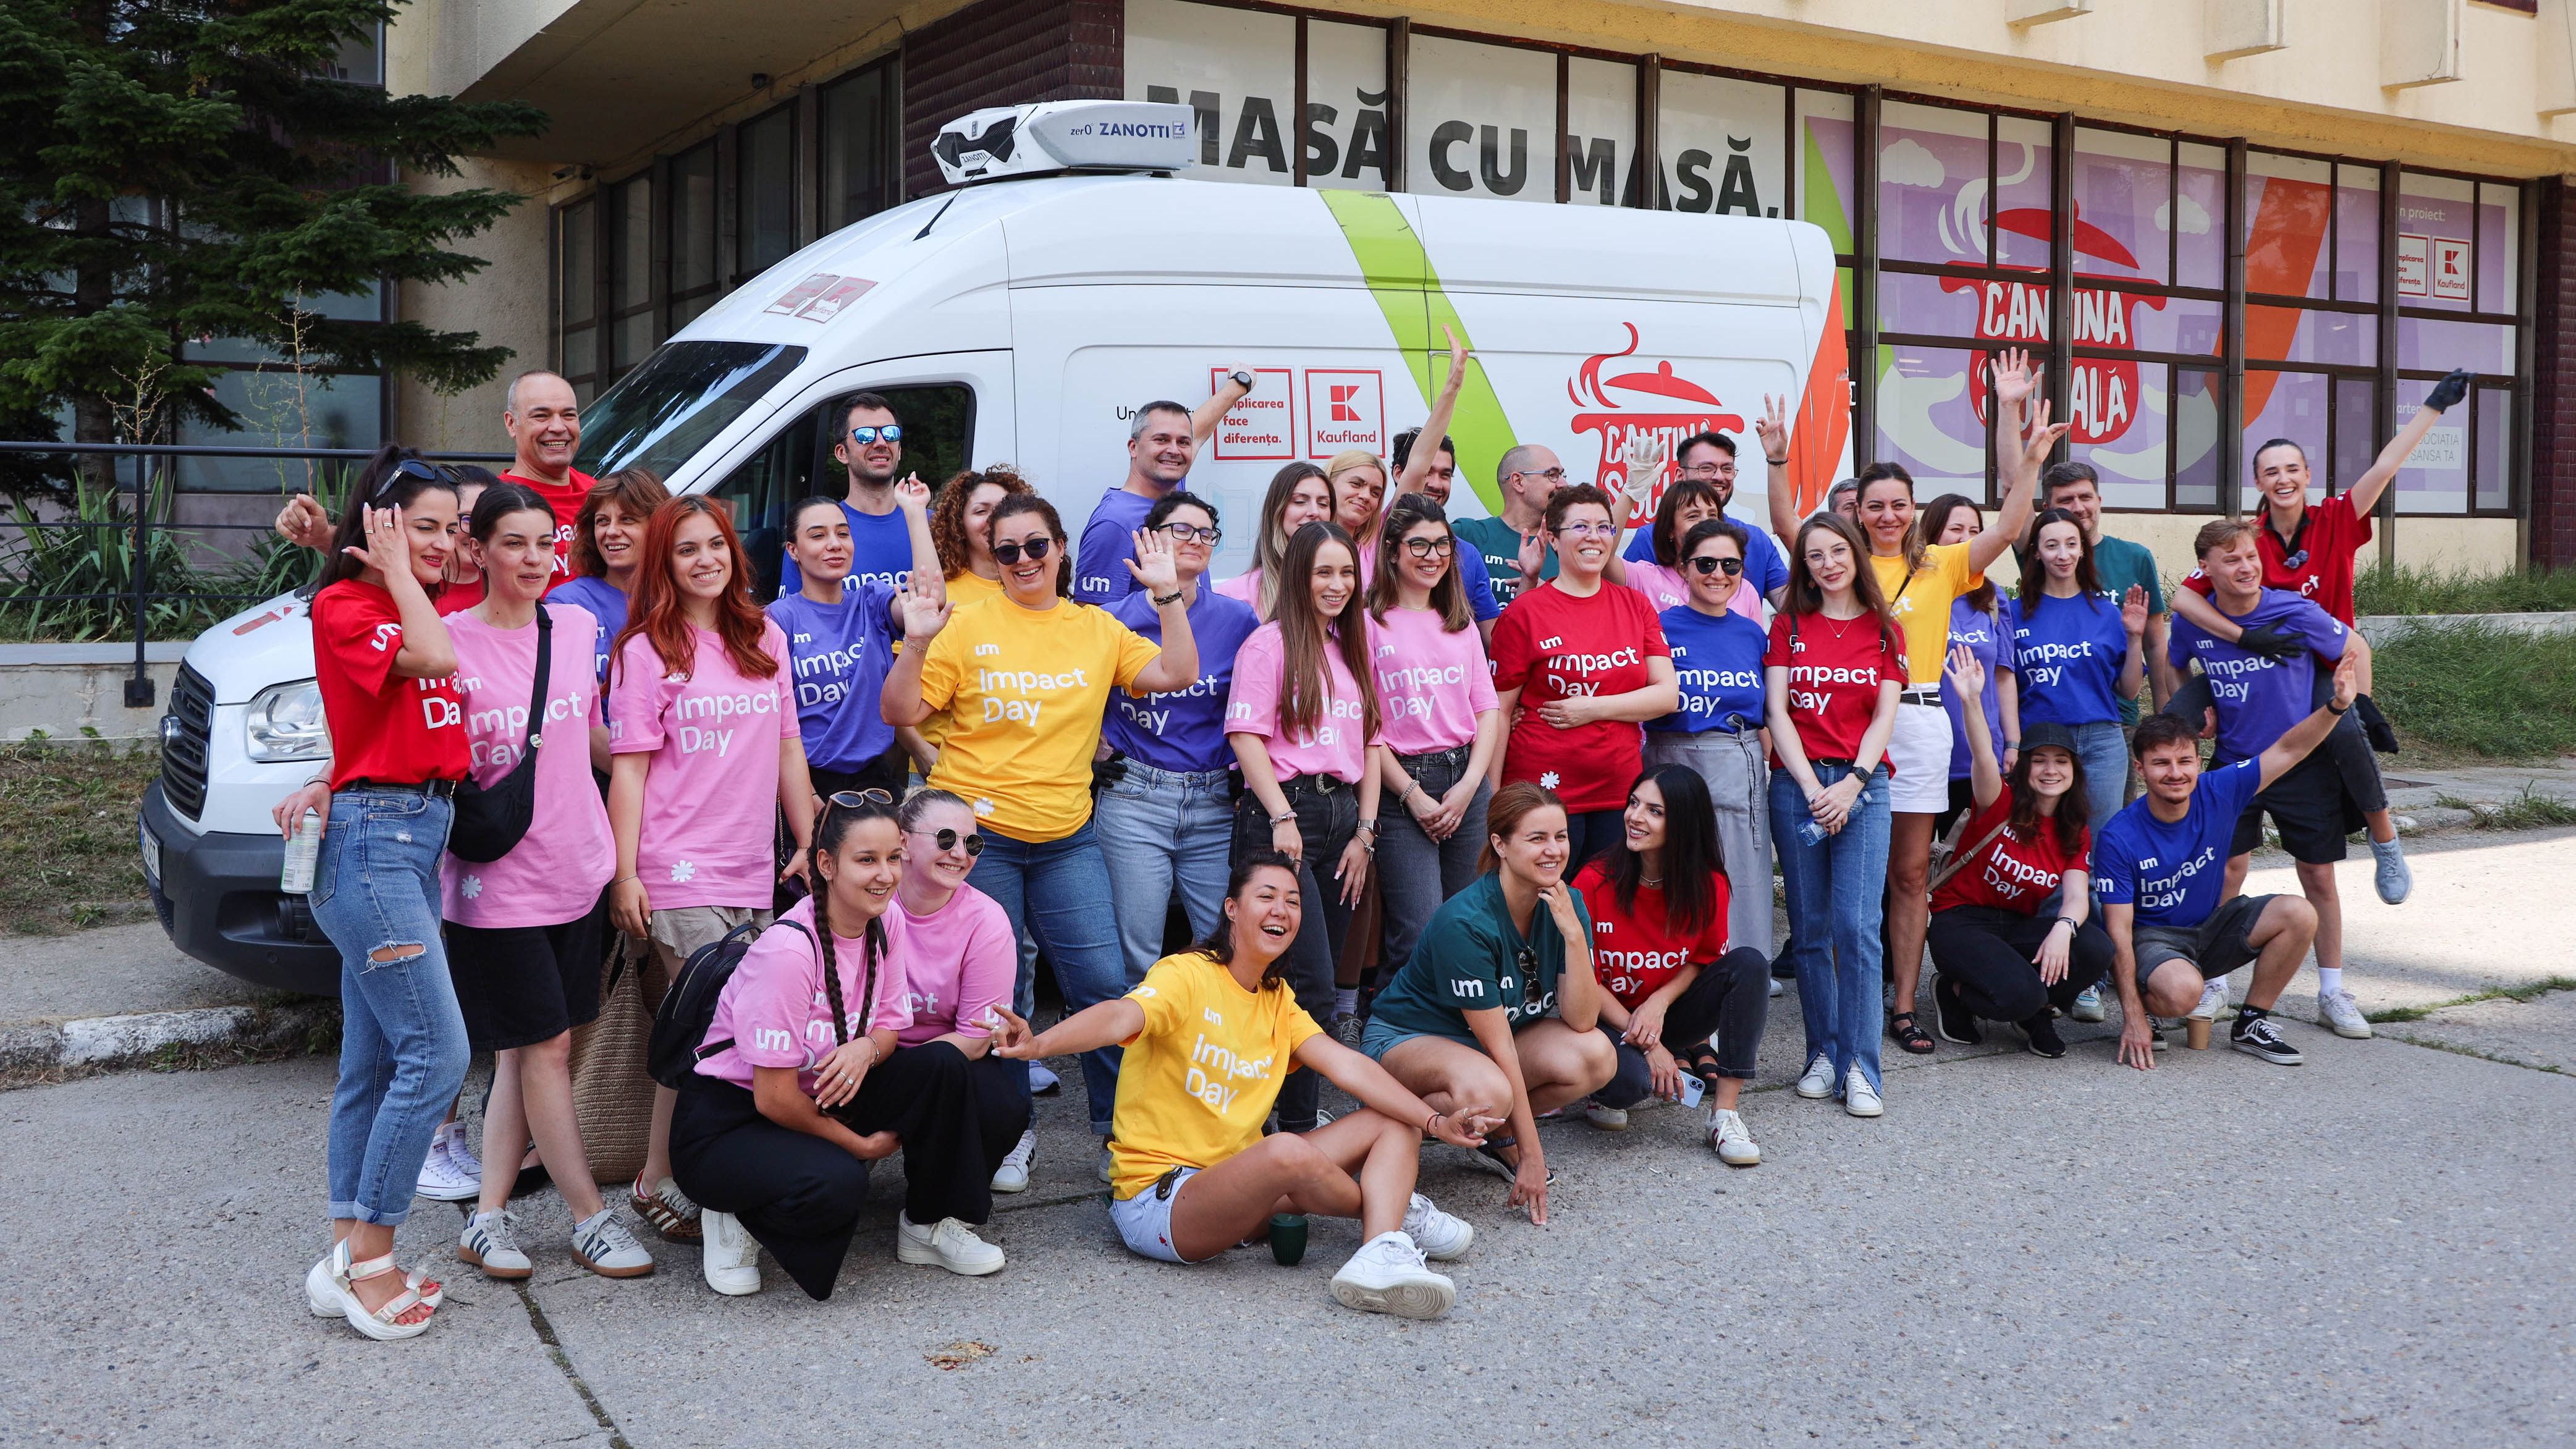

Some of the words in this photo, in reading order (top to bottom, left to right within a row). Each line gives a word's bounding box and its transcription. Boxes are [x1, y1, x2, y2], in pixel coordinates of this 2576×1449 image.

[1099, 123, 1169, 138] ZANOTTI
[962, 153, 987, 163] ZANOTTI
[1429, 120, 1527, 196] CU
[2398, 254, 2424, 263] mplicarea
[2398, 276, 2422, 286] iferența.
[2437, 279, 2465, 290] Kaufland
[1983, 282, 2127, 345] CANINA
[1233, 398, 1284, 410] plicarea
[1223, 415, 1248, 426] face
[1223, 433, 1282, 446] diferența.
[1317, 431, 1376, 442] Kaufland
[1605, 423, 1710, 464] CANTIN
[1485, 554, 1503, 565] um
[1082, 576, 1110, 593] um
[1660, 591, 1679, 606] um
[974, 643, 1000, 657] um
[1539, 635, 1562, 650] um
[2017, 640, 2092, 667] Impact
[2196, 640, 2214, 649] um
[1548, 646, 1639, 678] Impact
[2202, 655, 2281, 680] Impac
[979, 667, 1088, 695] Impact
[1548, 674, 1600, 697] Day
[1677, 670, 1760, 693] mpact
[2024, 665, 2062, 686] Day
[1791, 688, 1832, 716] Day
[2210, 679, 2249, 703] Day
[422, 696, 461, 729] Da
[469, 692, 583, 737] mpct
[676, 689, 779, 723] Impact
[983, 696, 1042, 727] Day
[1388, 695, 1435, 720] Day
[1121, 702, 1170, 736] Day
[679, 726, 733, 757] Day
[1989, 843, 2059, 889] Impac
[2140, 856, 2158, 870] um
[2140, 846, 2216, 893] Impact
[1983, 866, 2025, 900] Day
[2141, 888, 2187, 908] Day
[1597, 921, 1613, 934] m
[1599, 947, 1689, 973] mpact
[1451, 978, 1484, 998] um
[1204, 1007, 1222, 1026] um
[756, 1027, 790, 1051] um
[1185, 1067, 1238, 1114] Day
